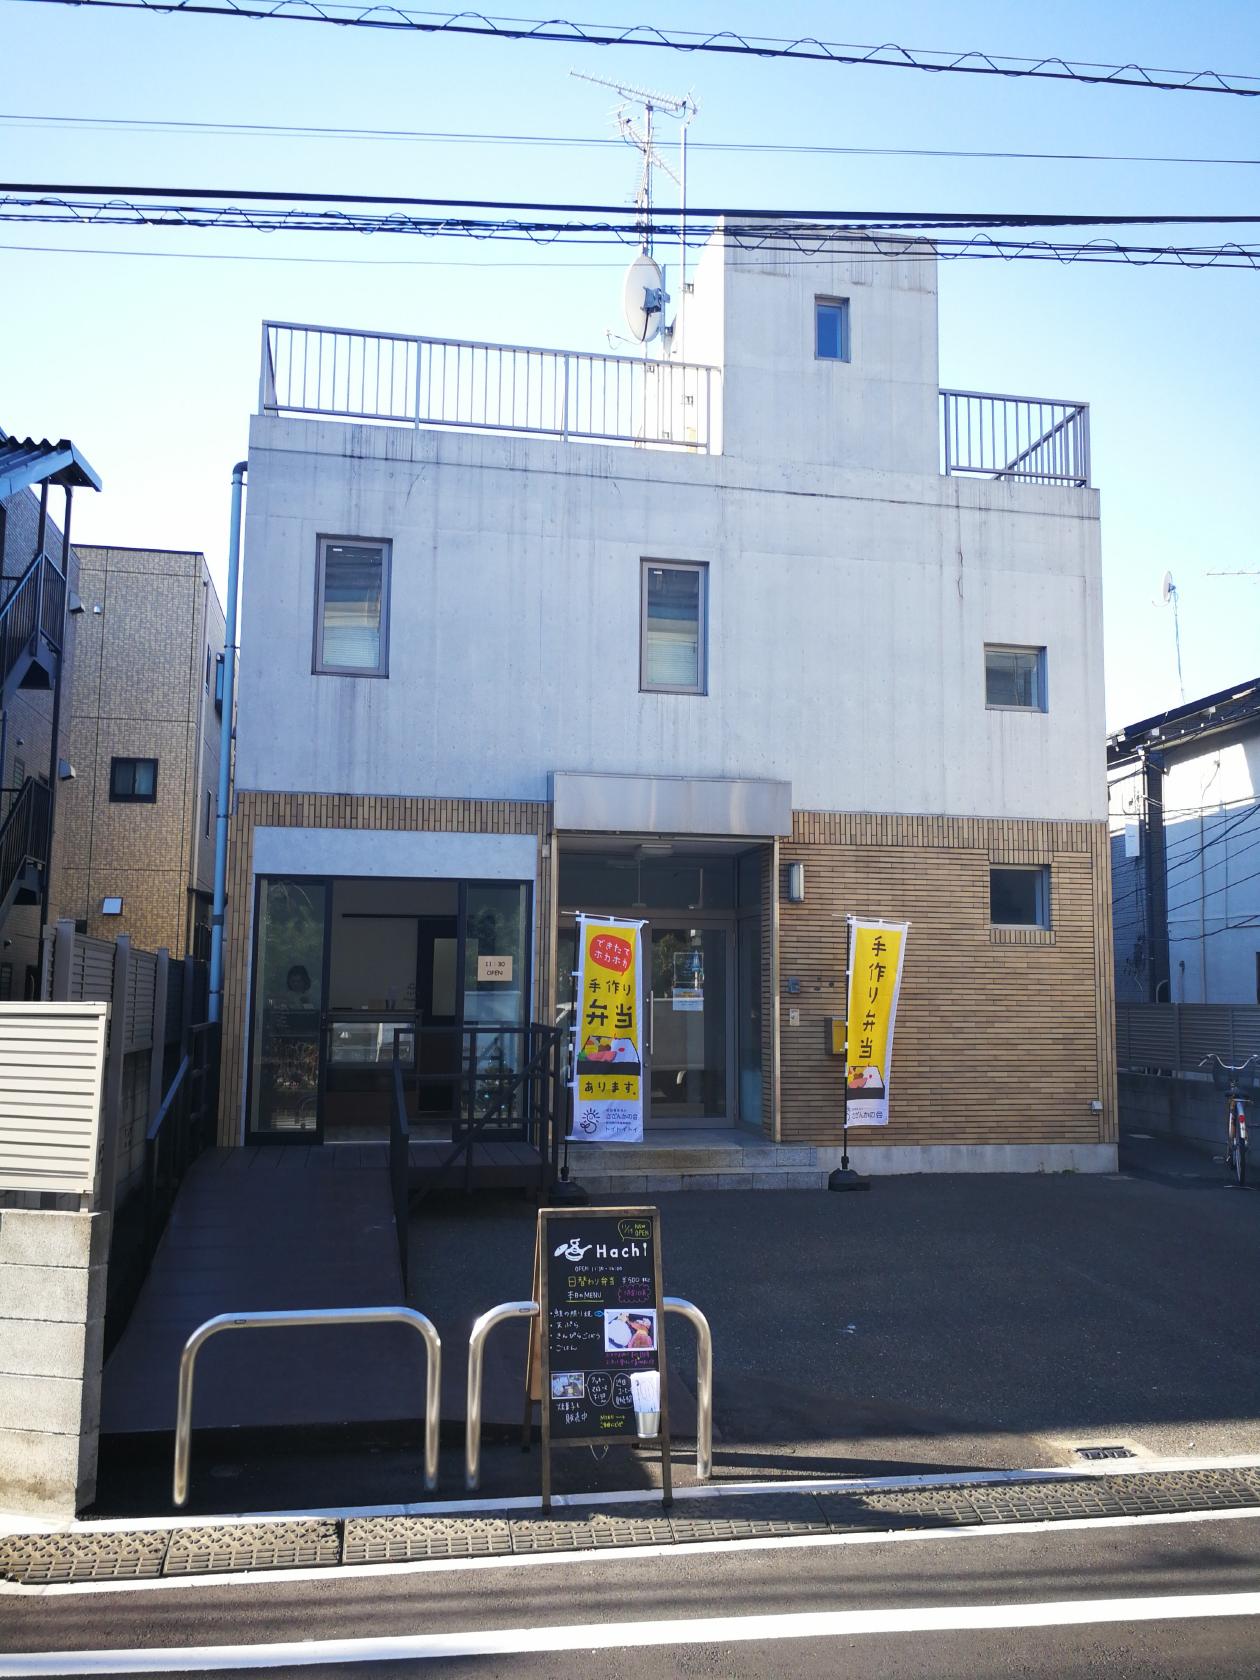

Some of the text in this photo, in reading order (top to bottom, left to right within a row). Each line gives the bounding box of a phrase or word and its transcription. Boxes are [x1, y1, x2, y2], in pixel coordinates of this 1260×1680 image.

[596, 939, 631, 956] できたて
[594, 950, 628, 969] ホカホカ
[588, 978, 632, 997] 手作り
[859, 935, 887, 1059] 手作り弁当
[585, 998, 633, 1029] 弁当
[584, 1080, 636, 1096] あります。
[567, 1275, 615, 1287] 日替わり弁当
